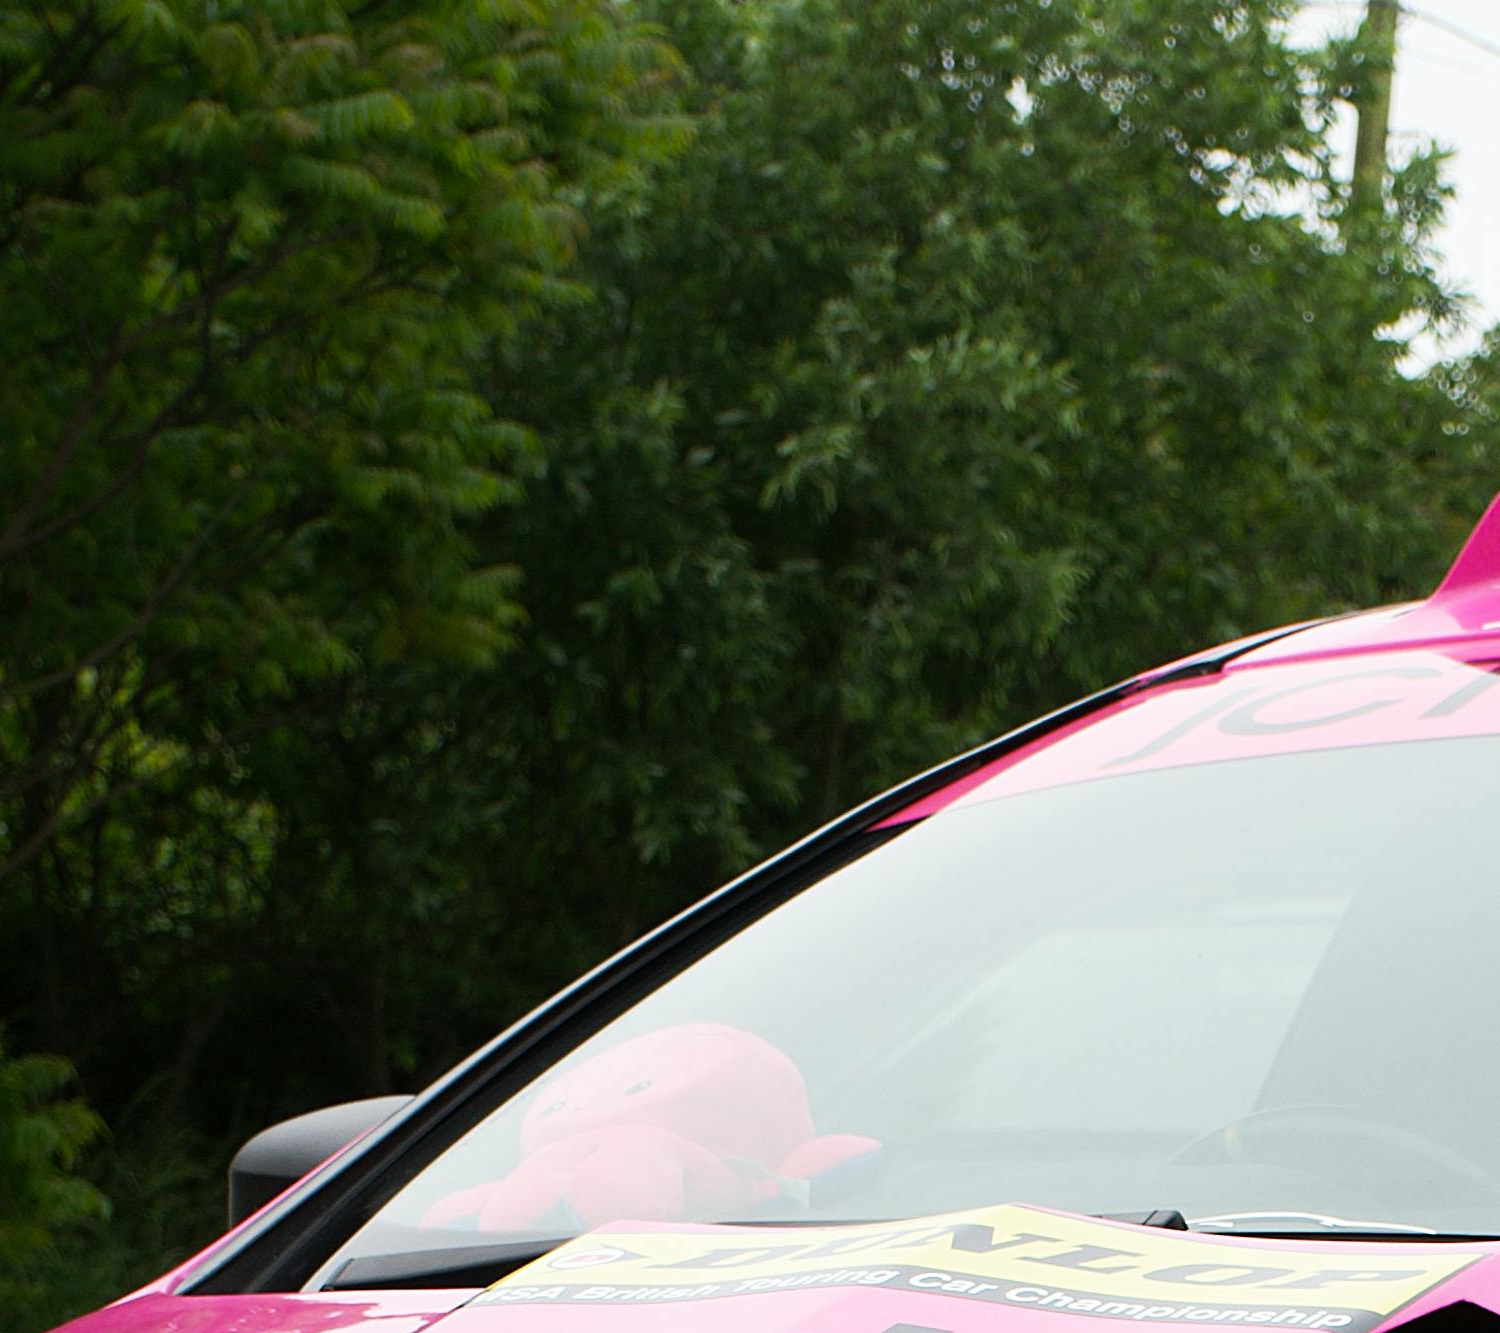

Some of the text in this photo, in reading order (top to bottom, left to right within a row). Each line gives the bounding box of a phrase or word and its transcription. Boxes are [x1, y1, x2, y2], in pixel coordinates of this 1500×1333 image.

[646, 1224, 1427, 1290] DUNLOP
[572, 1282, 719, 1301] British
[736, 1270, 900, 1295] Touring
[907, 1271, 998, 1295] Car
[1004, 1286, 1352, 1330] Championship
